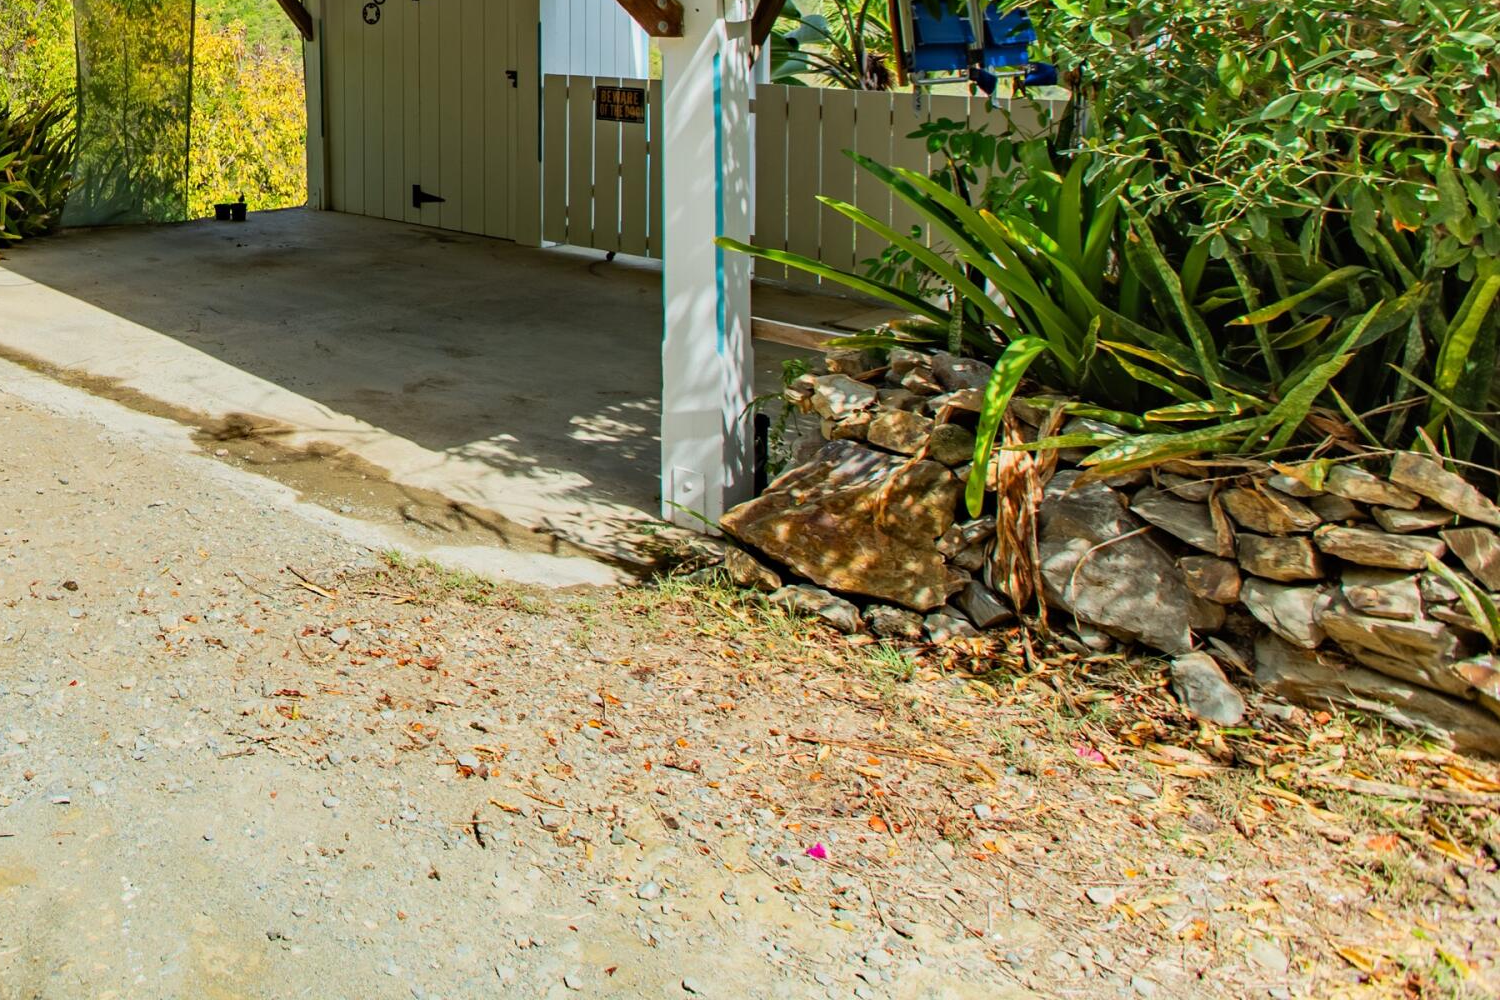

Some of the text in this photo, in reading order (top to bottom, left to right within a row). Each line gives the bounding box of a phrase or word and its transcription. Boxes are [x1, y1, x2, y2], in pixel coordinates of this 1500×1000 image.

[601, 90, 639, 105] BEWARE
[600, 104, 608, 116] OF
[611, 104, 624, 118] THE
